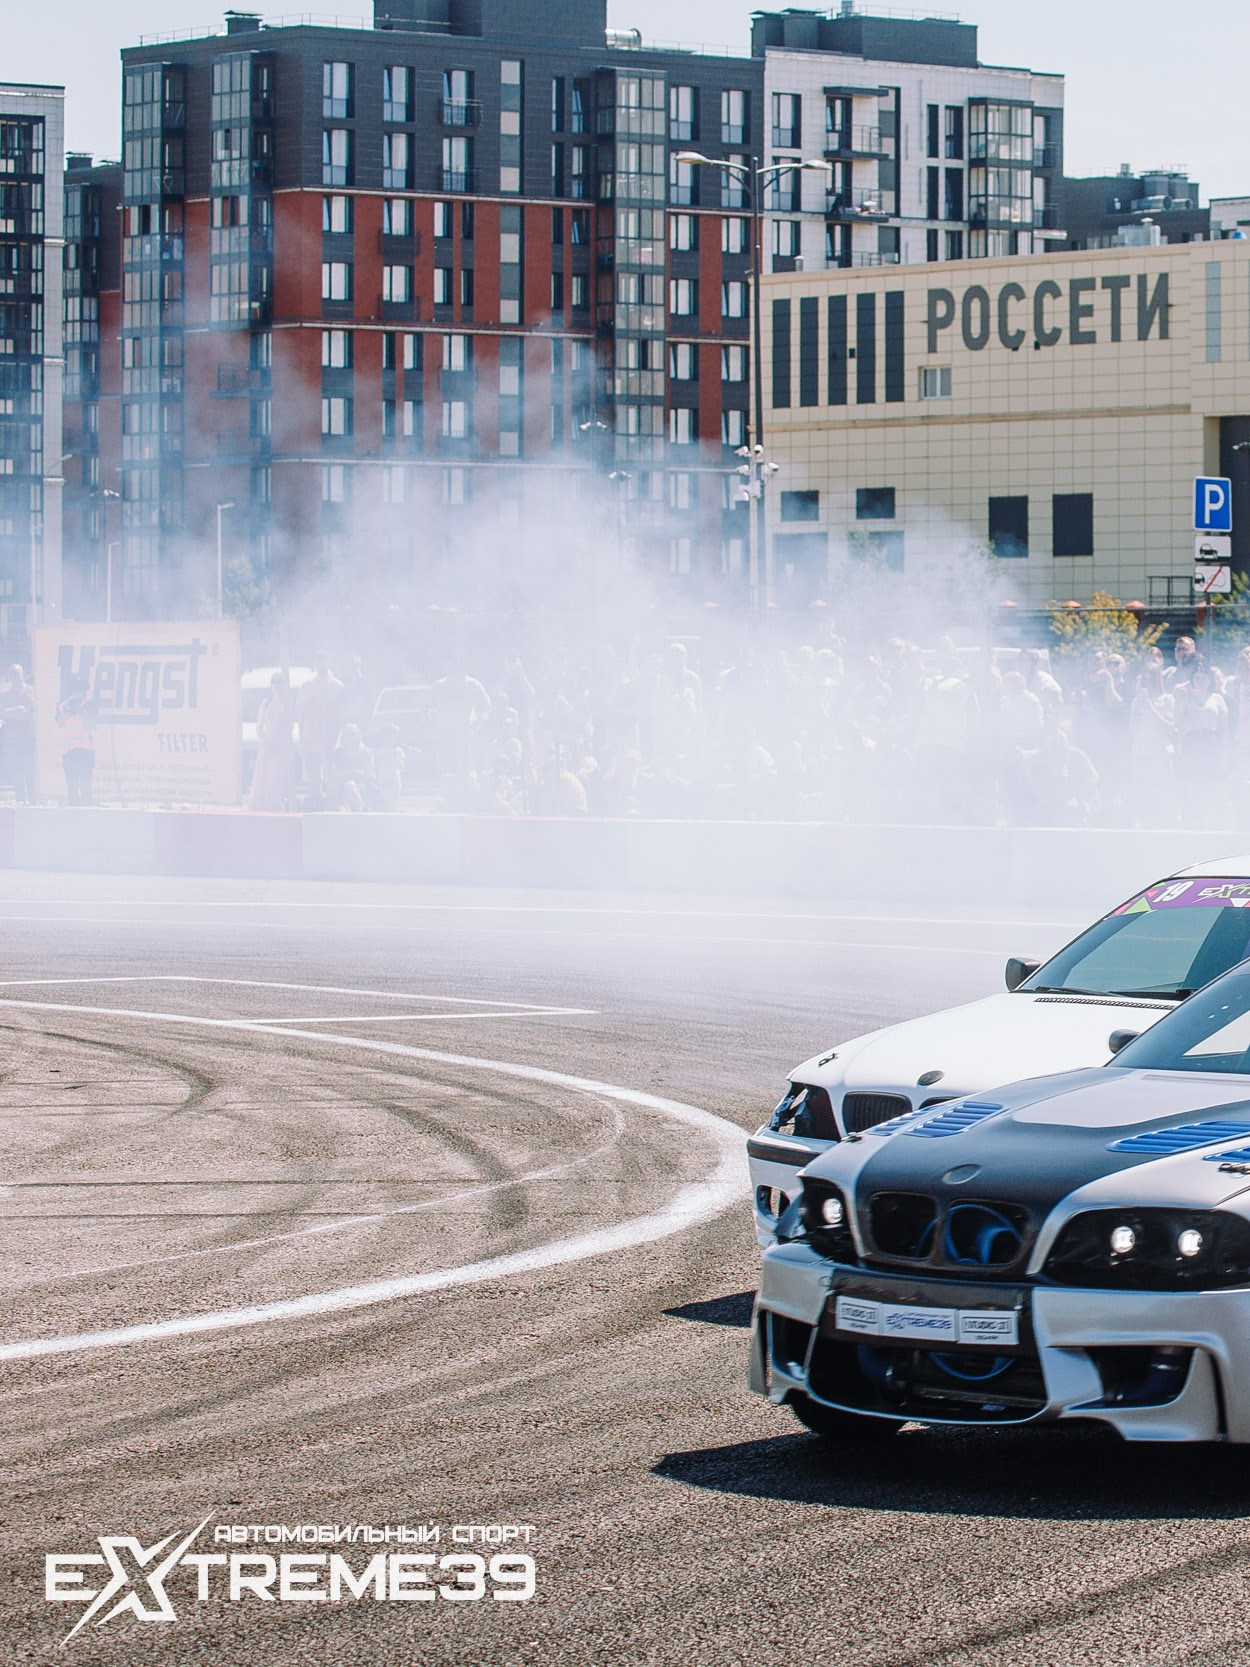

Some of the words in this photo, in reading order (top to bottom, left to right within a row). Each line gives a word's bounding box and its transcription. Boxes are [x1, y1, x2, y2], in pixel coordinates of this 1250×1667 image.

[927, 272, 1170, 353] РОССЕТИ
[1204, 483, 1225, 524] P
[158, 733, 208, 752] FILTER
[1152, 880, 1195, 903] 19
